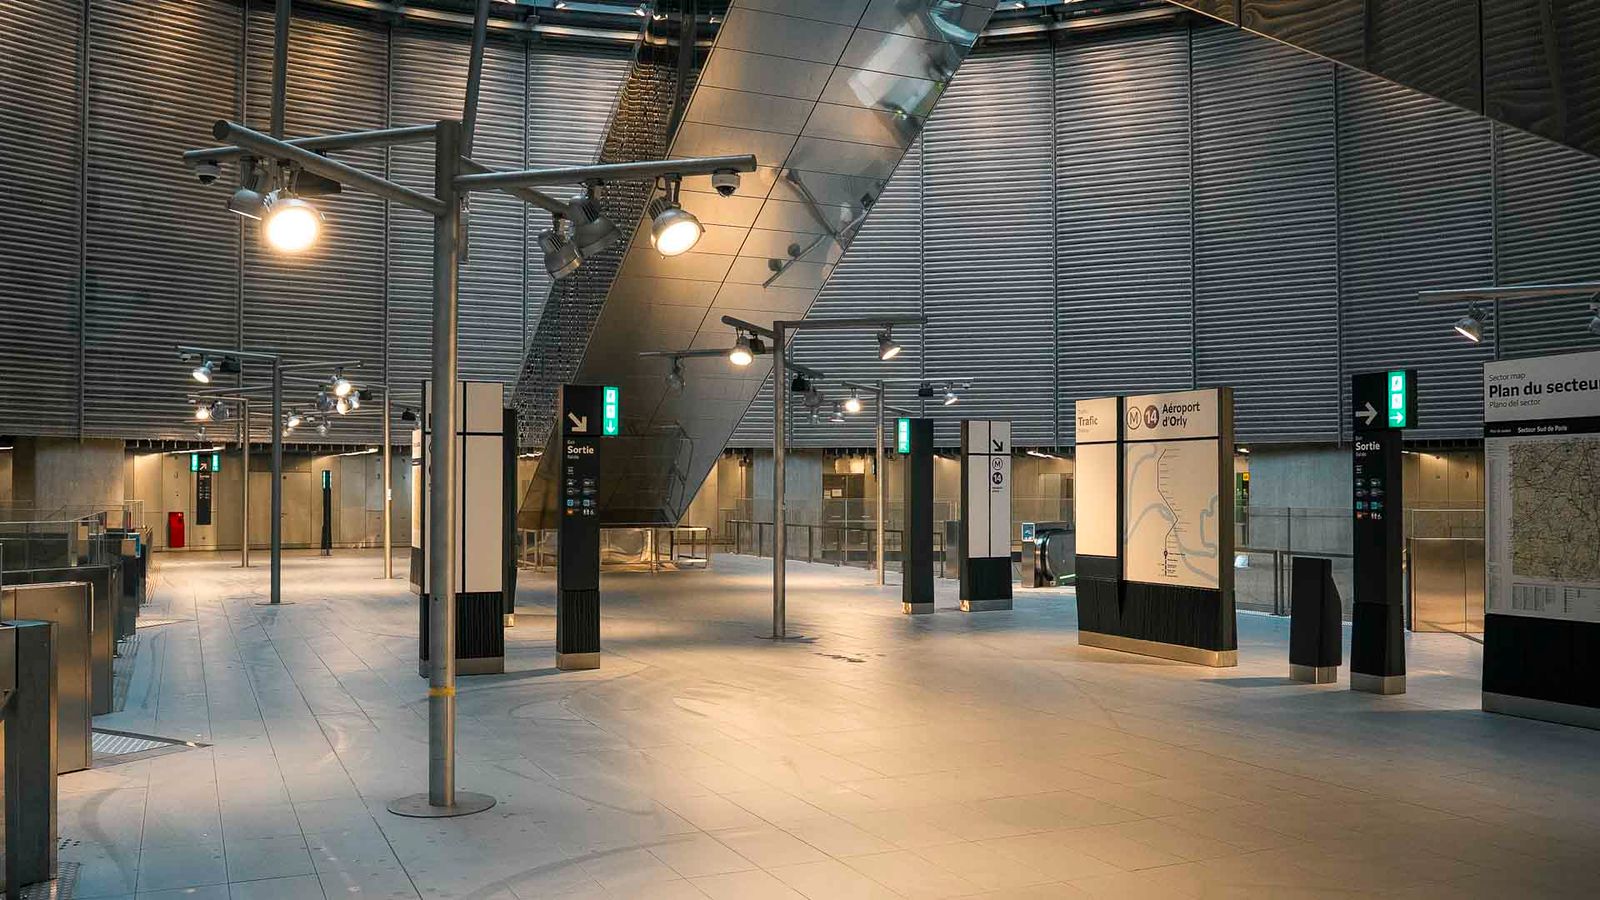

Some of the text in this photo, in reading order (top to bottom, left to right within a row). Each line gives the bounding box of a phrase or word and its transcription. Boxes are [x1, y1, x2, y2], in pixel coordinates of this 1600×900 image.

[1489, 373, 1526, 382] Sector map
[1489, 379, 1600, 398] Plan du secteu
[1162, 401, 1201, 414] Aéroport
[1489, 399, 1541, 409] Plano del sector
[1077, 415, 1098, 427] Trafic
[1145, 410, 1157, 424] 14
[1162, 415, 1188, 428] d'Orly
[567, 445, 594, 455] Sortie
[1355, 441, 1381, 451] Sortie
